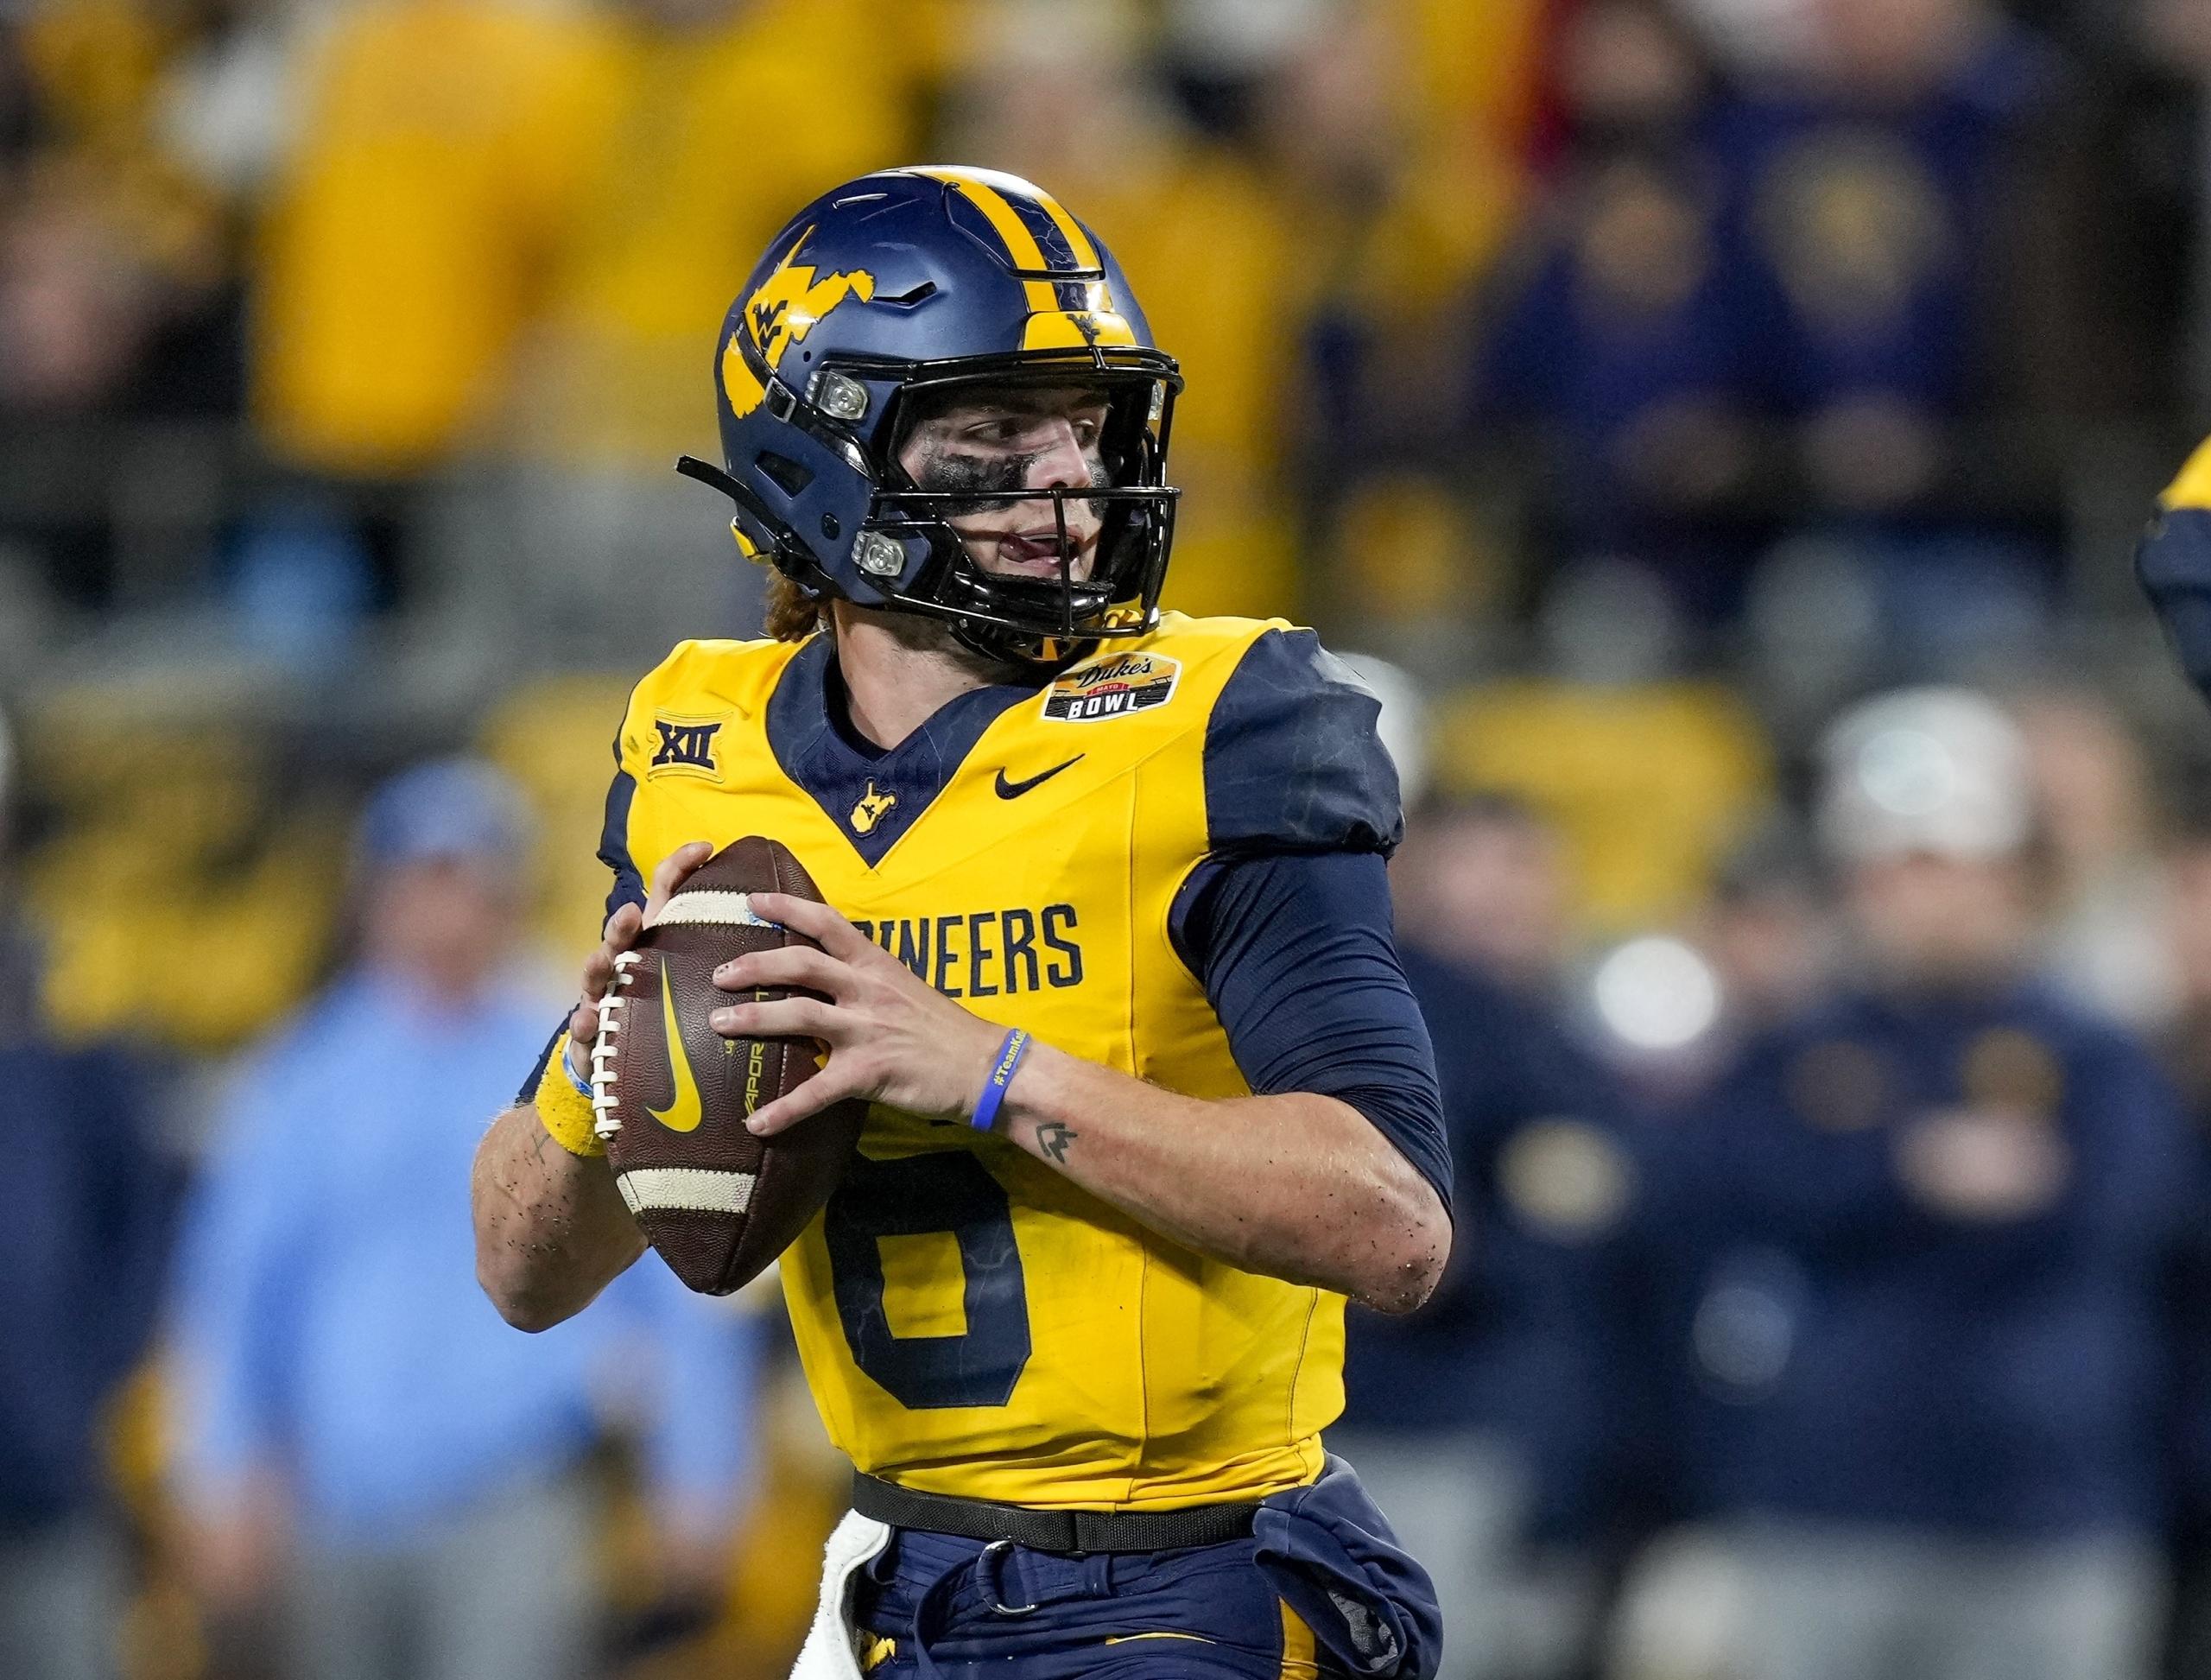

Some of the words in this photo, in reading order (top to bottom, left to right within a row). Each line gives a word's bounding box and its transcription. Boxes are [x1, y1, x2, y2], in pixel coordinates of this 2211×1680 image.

[1077, 657, 1153, 688] Duke's
[1097, 683, 1119, 692] MAYO
[1067, 692, 1138, 720] BOWL
[652, 720, 722, 770] XII
[824, 1119, 1033, 1411] 6
